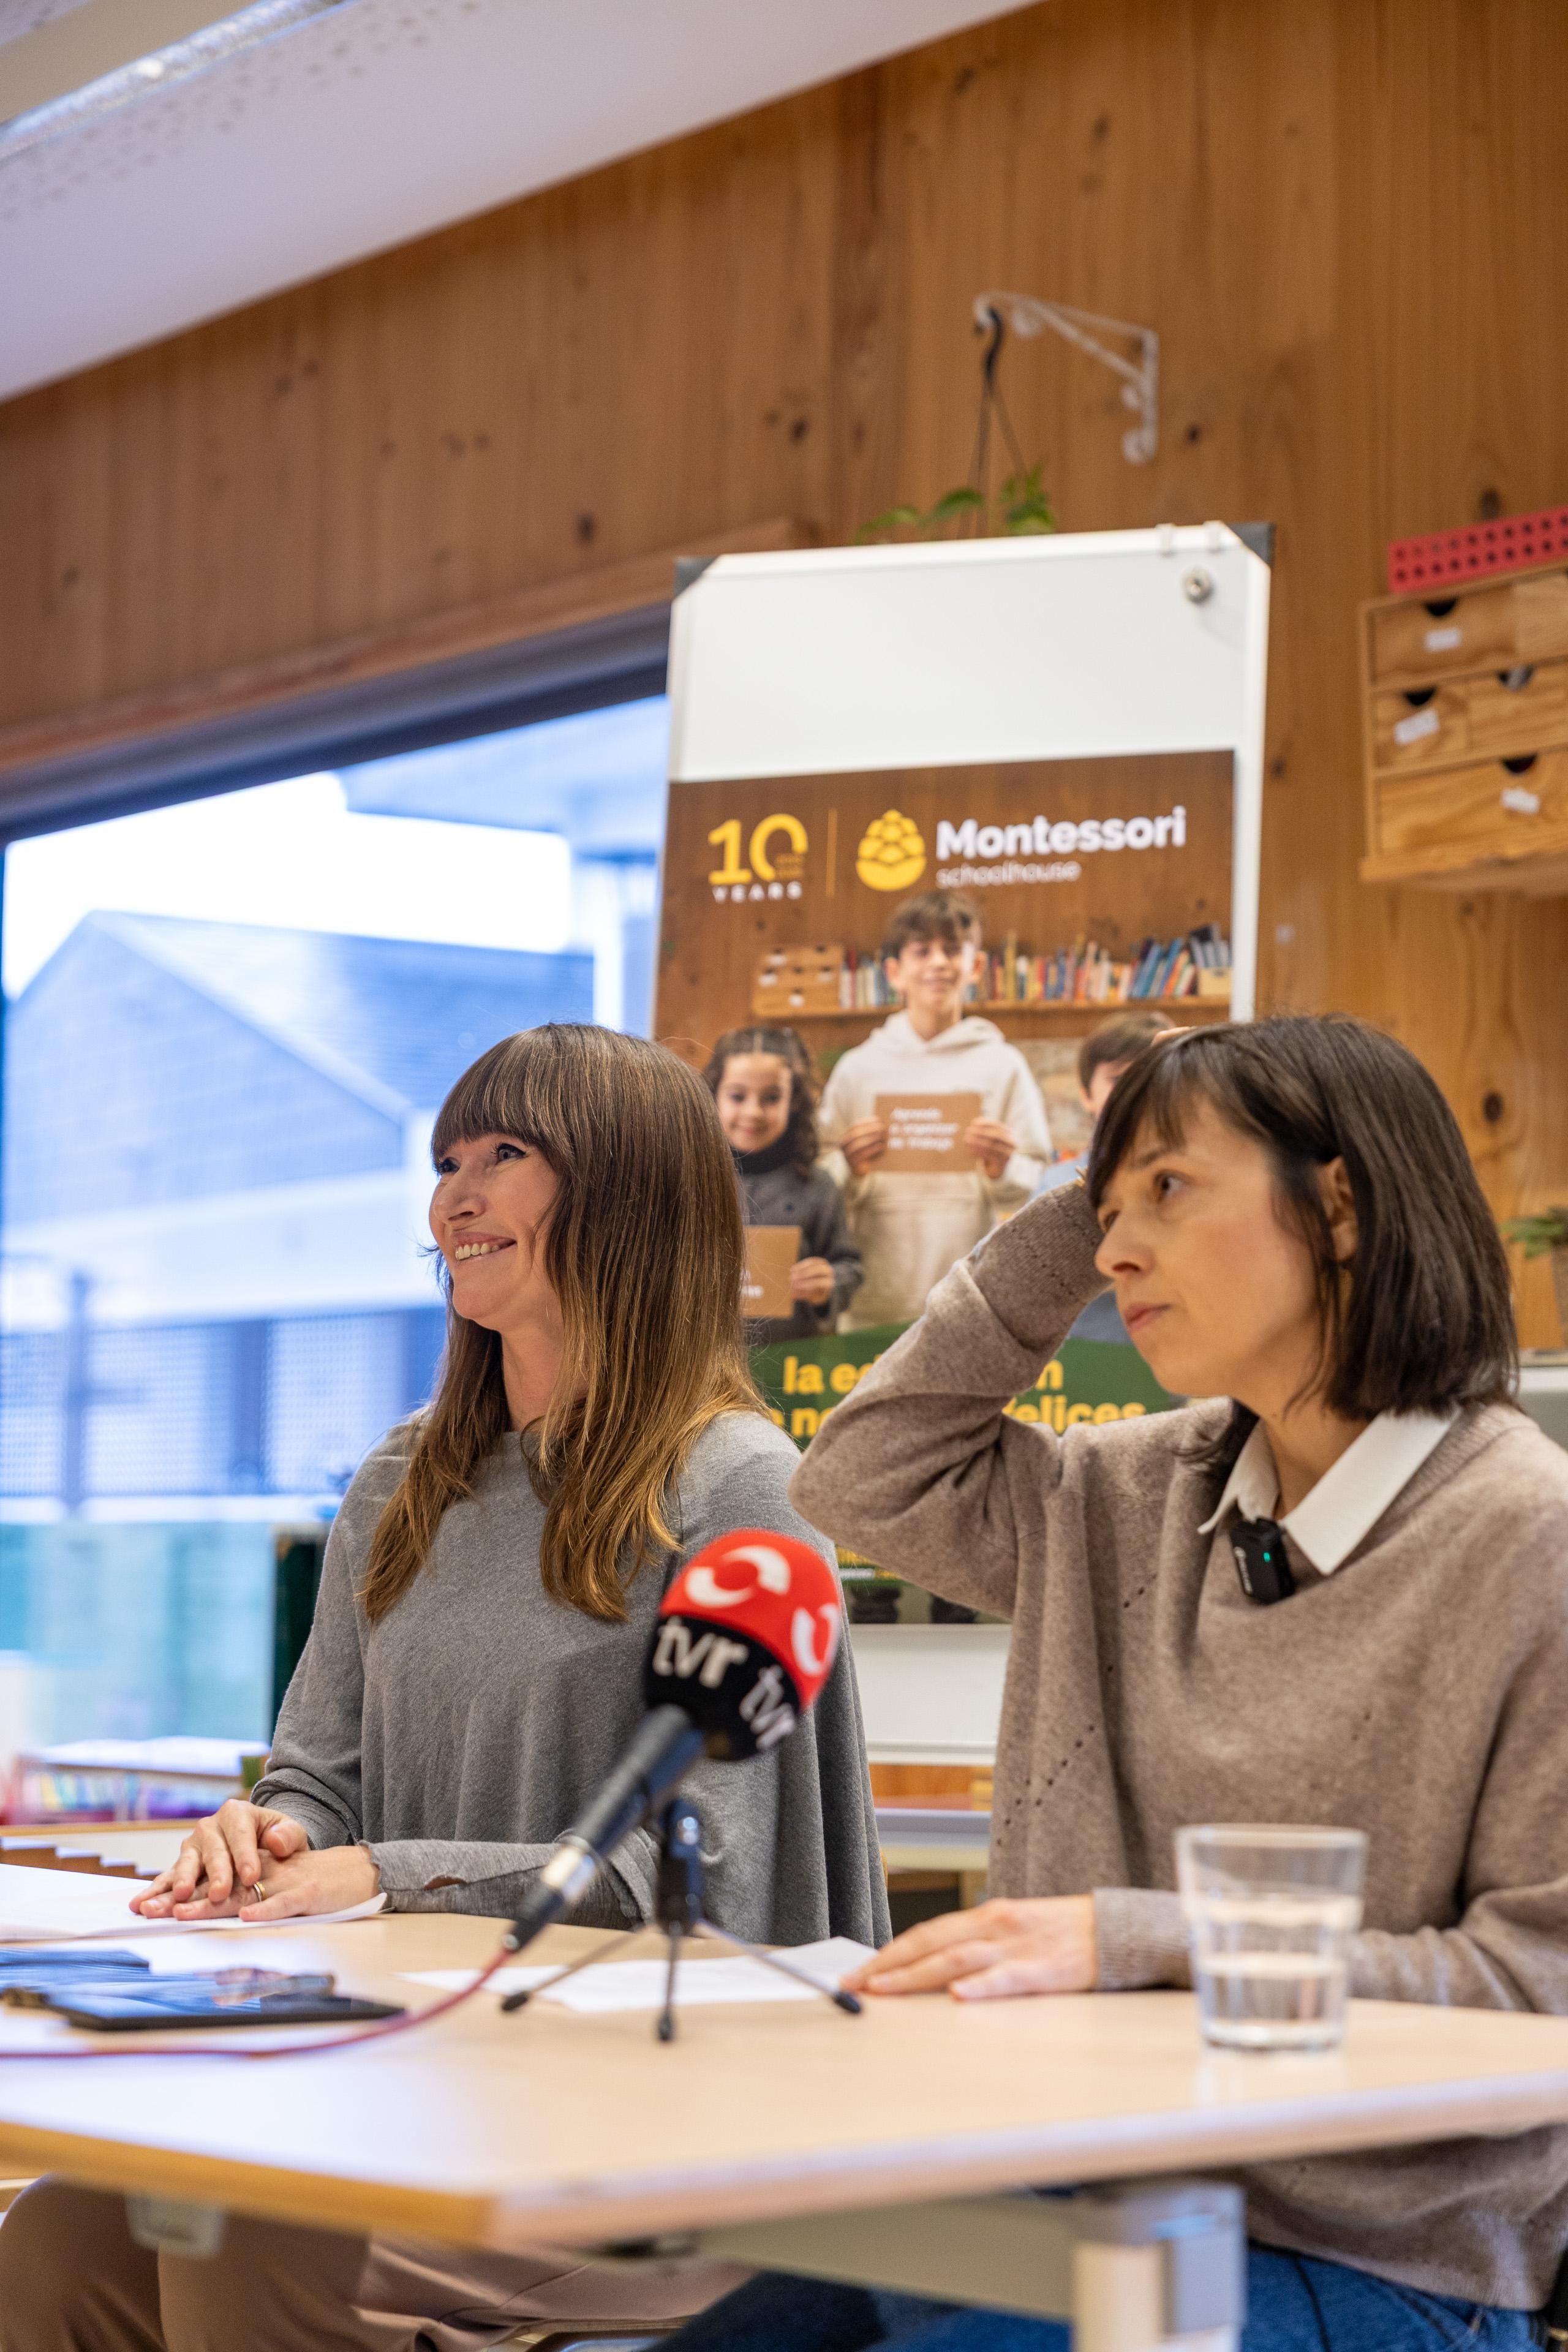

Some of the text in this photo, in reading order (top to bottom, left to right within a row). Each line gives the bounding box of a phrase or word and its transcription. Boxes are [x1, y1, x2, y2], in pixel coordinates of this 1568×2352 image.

[708, 813, 809, 885] 10
[936, 805, 1186, 861] Montessori
[712, 881, 802, 904] YEARS
[935, 861, 1082, 889] schoolhouse
[783, 1355, 825, 1395] la
[652, 1615, 748, 1689] tvr
